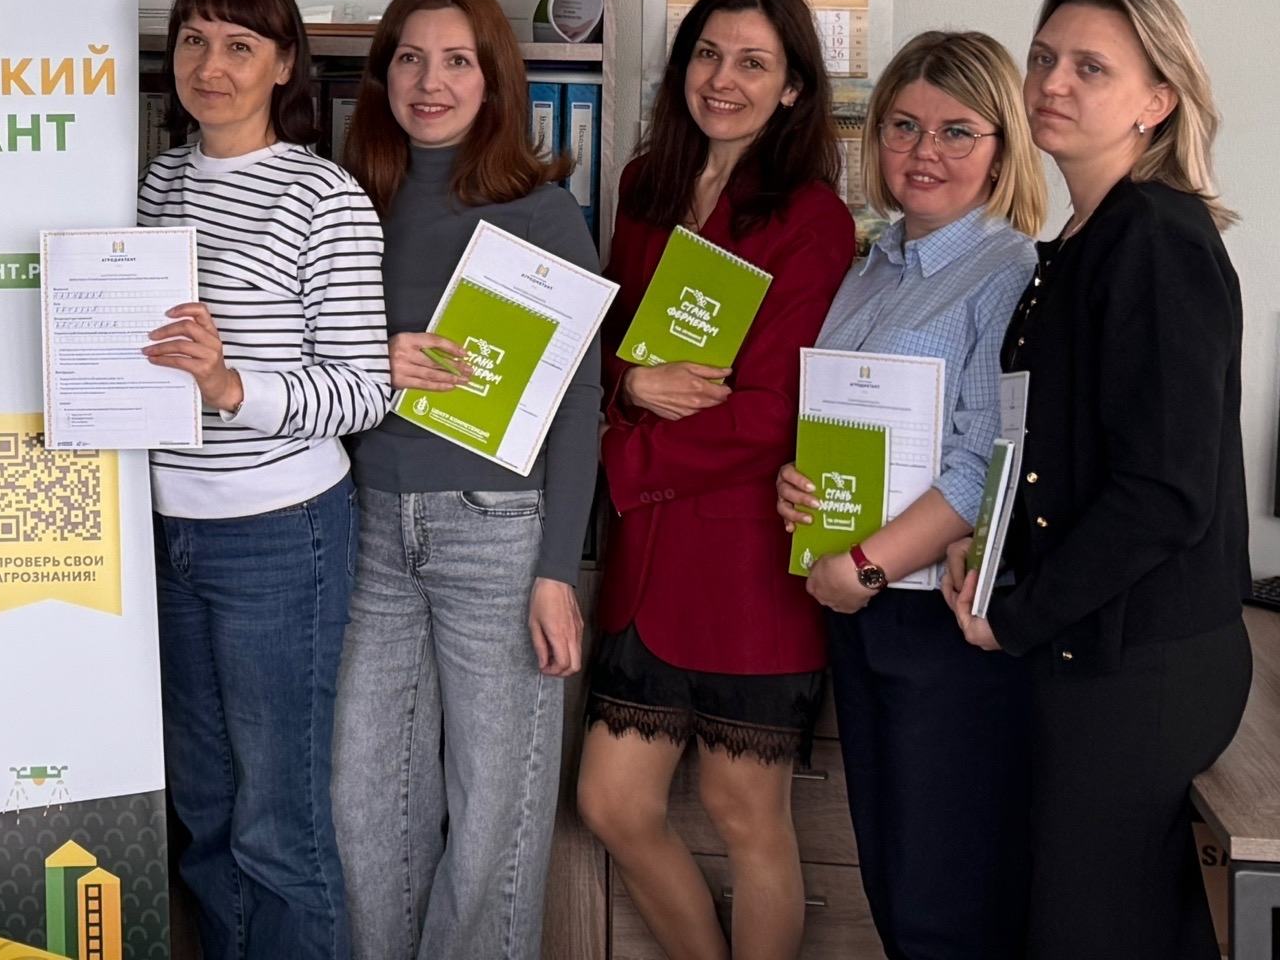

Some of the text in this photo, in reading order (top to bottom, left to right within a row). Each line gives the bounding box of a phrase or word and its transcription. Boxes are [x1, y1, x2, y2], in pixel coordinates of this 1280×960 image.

[835, 13, 841, 22] 5
[832, 25, 843, 35] 12
[832, 37, 843, 47] 19
[831, 49, 844, 59] 26
[680, 301, 711, 320] СТАНЬ
[667, 307, 719, 337] ФЕРМЕРОМ
[825, 488, 852, 501] СТАНЬ
[64, 555, 105, 568] СВОИ
